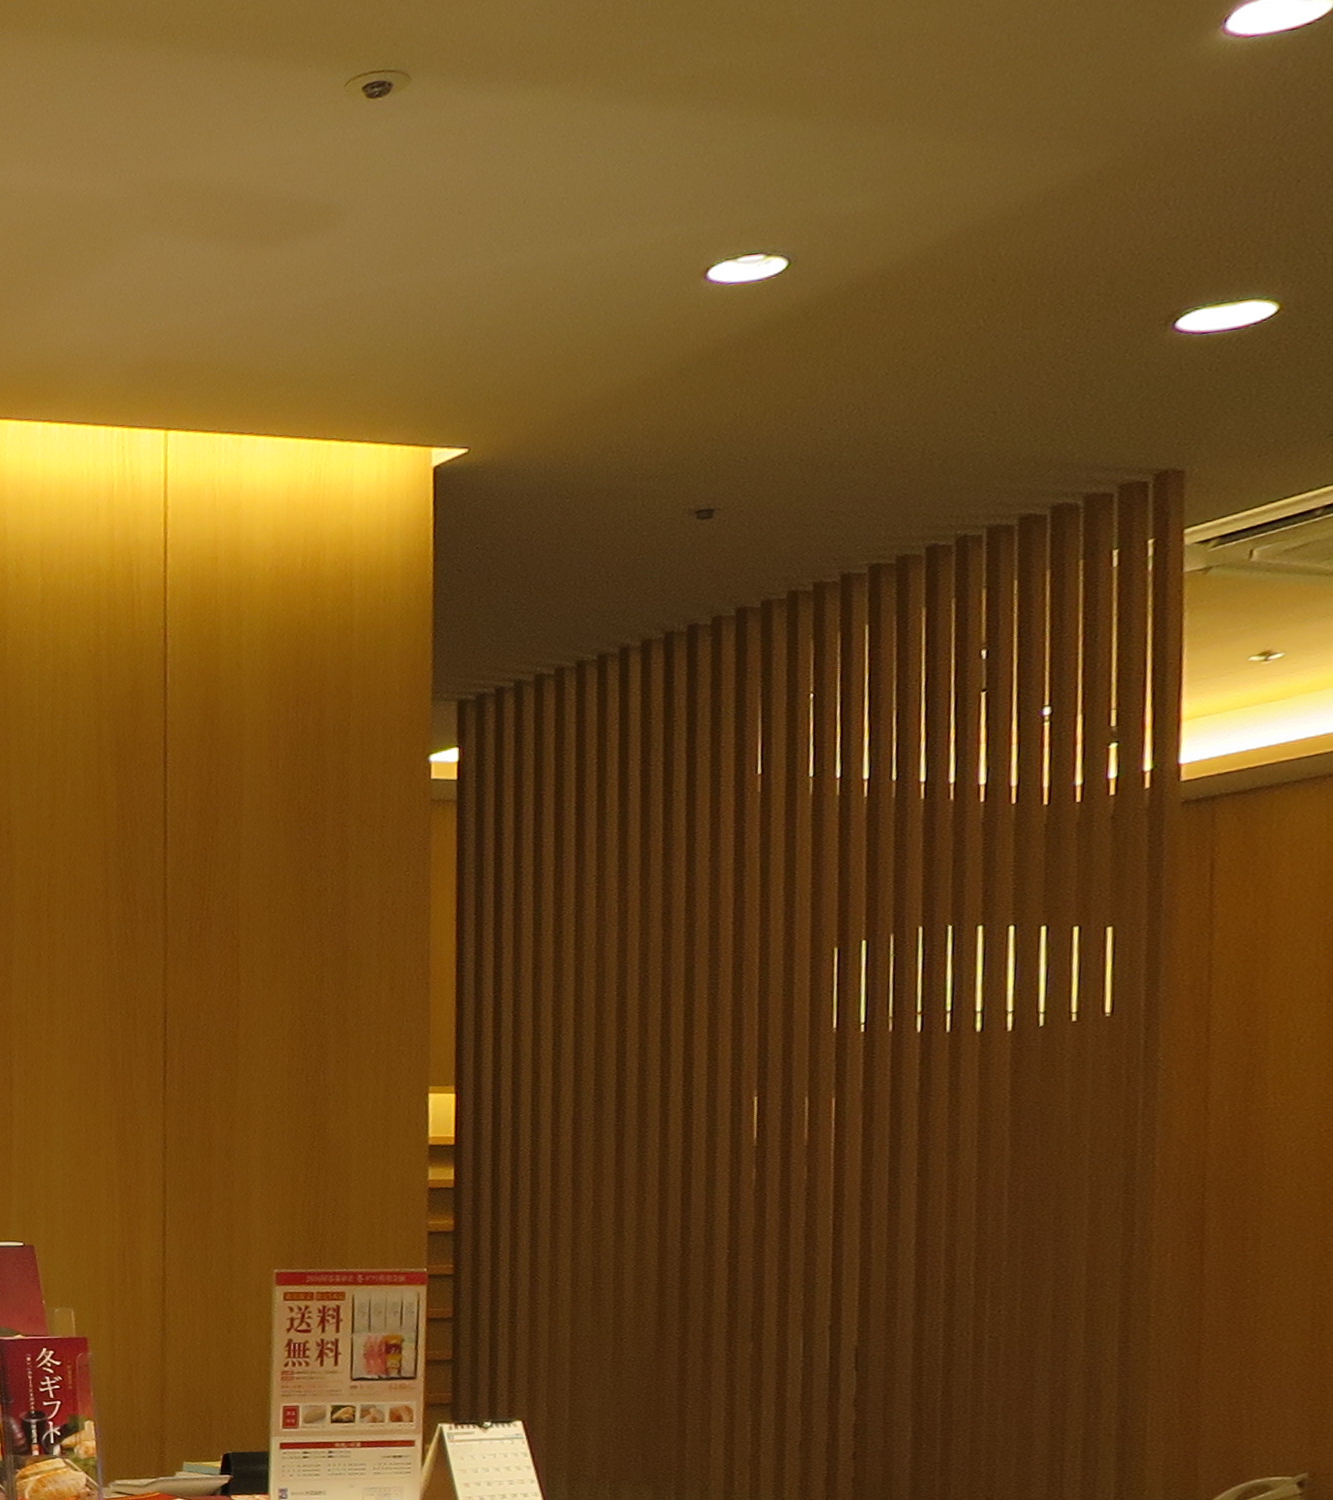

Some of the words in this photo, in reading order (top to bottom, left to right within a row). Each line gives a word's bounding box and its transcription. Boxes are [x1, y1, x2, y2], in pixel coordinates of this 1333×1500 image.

[285, 1304, 344, 1335] 送料
[284, 1337, 342, 1368] 無料
[36, 1346, 63, 1445] 冬ギフト
